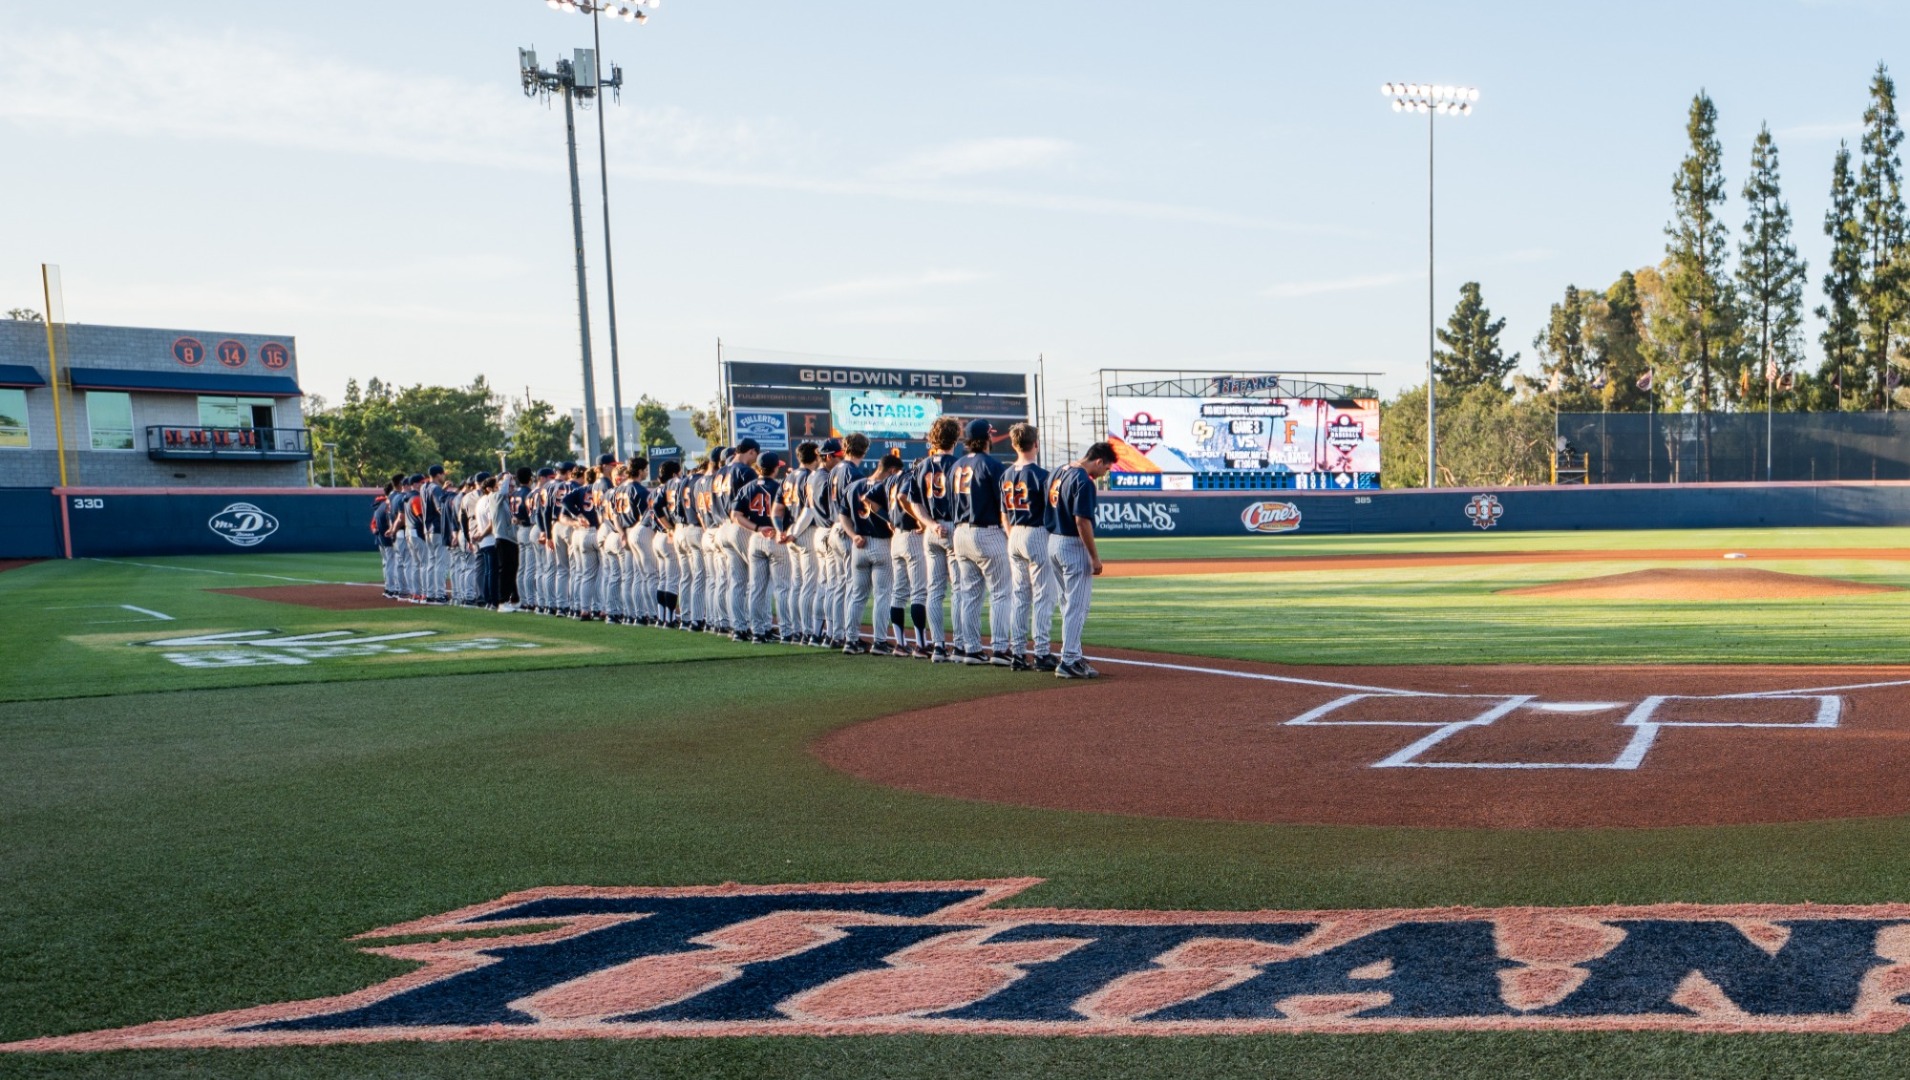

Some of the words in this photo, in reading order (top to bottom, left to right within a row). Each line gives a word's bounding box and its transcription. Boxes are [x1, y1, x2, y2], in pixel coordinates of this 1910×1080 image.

[184, 347, 194, 362] 8
[224, 348, 240, 364] 14
[266, 350, 283, 366] 16
[800, 369, 903, 386] GOODWIN
[910, 373, 967, 388] FIELD
[1212, 375, 1279, 395] TITANS
[850, 402, 925, 419] ONTARIO
[740, 414, 782, 428] FULLERTON
[804, 414, 817, 436] F
[1231, 420, 1254, 434] GAME
[1284, 420, 1298, 444] F
[924, 471, 946, 499] 19
[954, 466, 973, 494] 12
[1117, 475, 1138, 486] 7:01
[1140, 475, 1155, 486] PM
[1003, 480, 1031, 511] 22
[1049, 478, 1062, 508] 6
[74, 498, 104, 509] 330
[215, 520, 237, 529] Mr.
[230, 512, 273, 532] D's
[1094, 501, 1176, 530] RIAN'S
[1246, 502, 1301, 529] Cane's
[1100, 522, 1123, 531] Original
[1125, 522, 1142, 530] Sports
